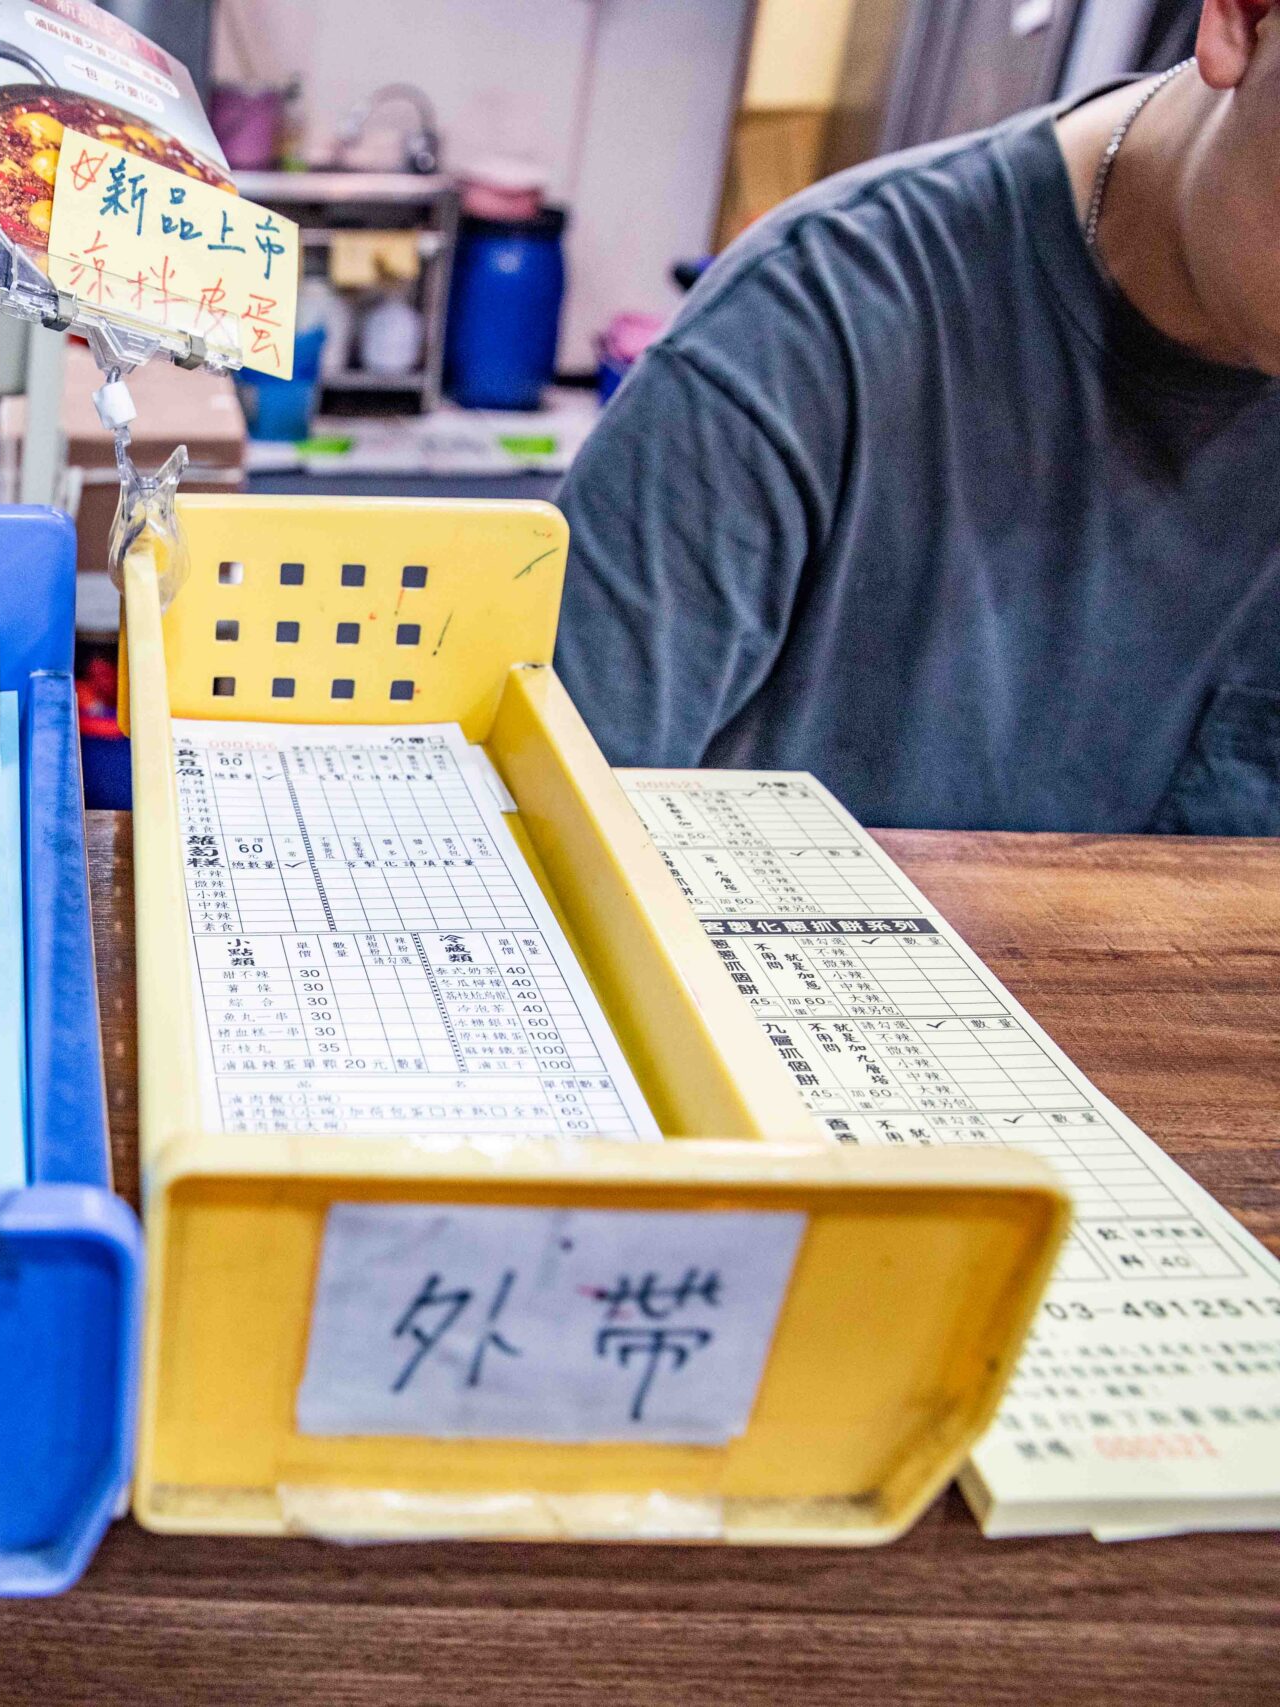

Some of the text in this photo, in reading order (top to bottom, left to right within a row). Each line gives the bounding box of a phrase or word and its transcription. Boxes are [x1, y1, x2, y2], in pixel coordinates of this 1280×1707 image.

[100, 158, 285, 279] 新品上市
[220, 757, 242, 765] 80
[239, 844, 263, 853] 60
[299, 969, 321, 978] 30
[506, 967, 526, 975] 40
[303, 983, 325, 992] 30
[511, 979, 532, 987] 40
[517, 992, 537, 1000] 40
[306, 997, 328, 1006] 30
[522, 1005, 543, 1013] 40
[310, 1011, 332, 1021] 30
[528, 1018, 549, 1027] 60
[314, 1027, 336, 1036] 30
[528, 1032, 558, 1041] 100
[318, 1043, 340, 1053] 35
[534, 1046, 564, 1055] 100
[540, 1060, 571, 1069] 100
[554, 1093, 577, 1103] 50
[567, 1121, 589, 1130] 60
[391, 1267, 722, 1422] 外帶
